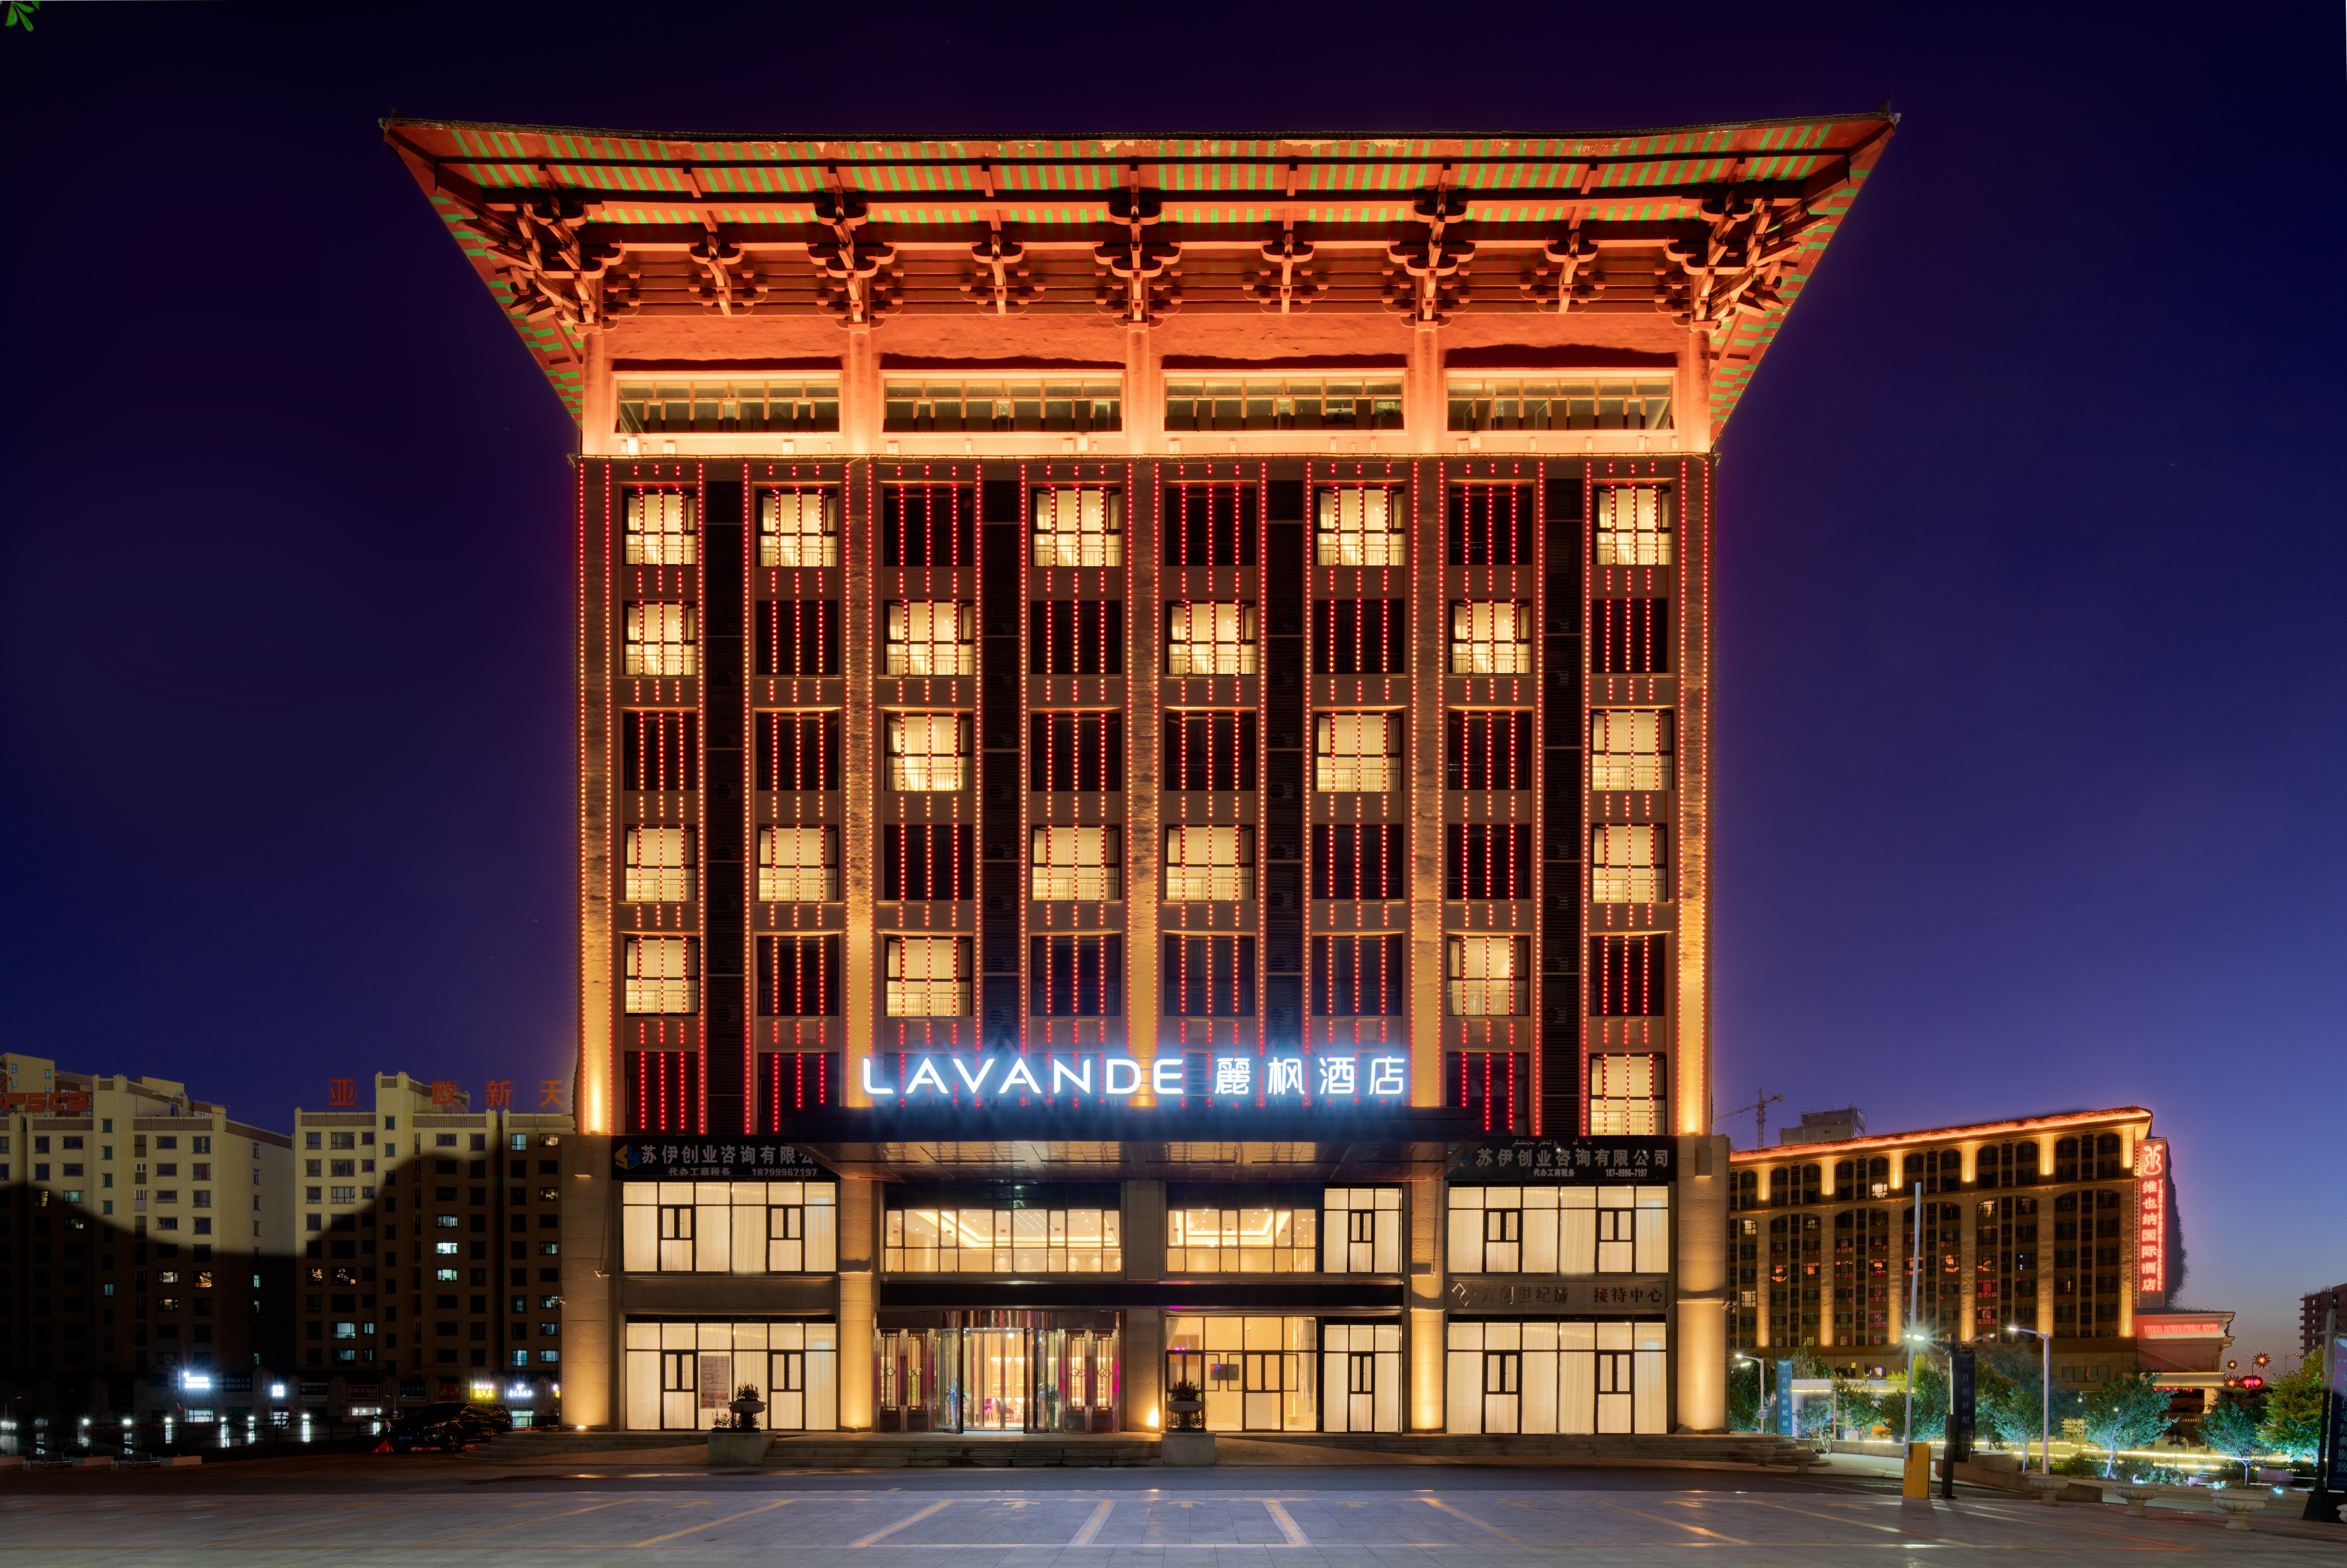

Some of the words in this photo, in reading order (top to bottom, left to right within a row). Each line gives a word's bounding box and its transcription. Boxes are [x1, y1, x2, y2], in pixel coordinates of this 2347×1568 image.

[863, 1057, 1185, 1095] LAVANDE
[1214, 1055, 1406, 1095] 麗枫酒店
[1476, 1148, 1669, 1167] 苏伊创业咨询有限公司
[1533, 1168, 1575, 1177] 代办工商税务
[1605, 1169, 1648, 1177] 187-9996-7197
[2141, 1180, 2157, 1292] 维也纳国际酒店
[1481, 1286, 1569, 1304] 万创世纪城
[1593, 1287, 1663, 1303] 接待中心
[2144, 1325, 2163, 1334] VIENNA
[2164, 1324, 2202, 1334] INTERNATIONAL
[2202, 1323, 2219, 1333] HOTEL
[1962, 1373, 1970, 1423] 万创世纪
